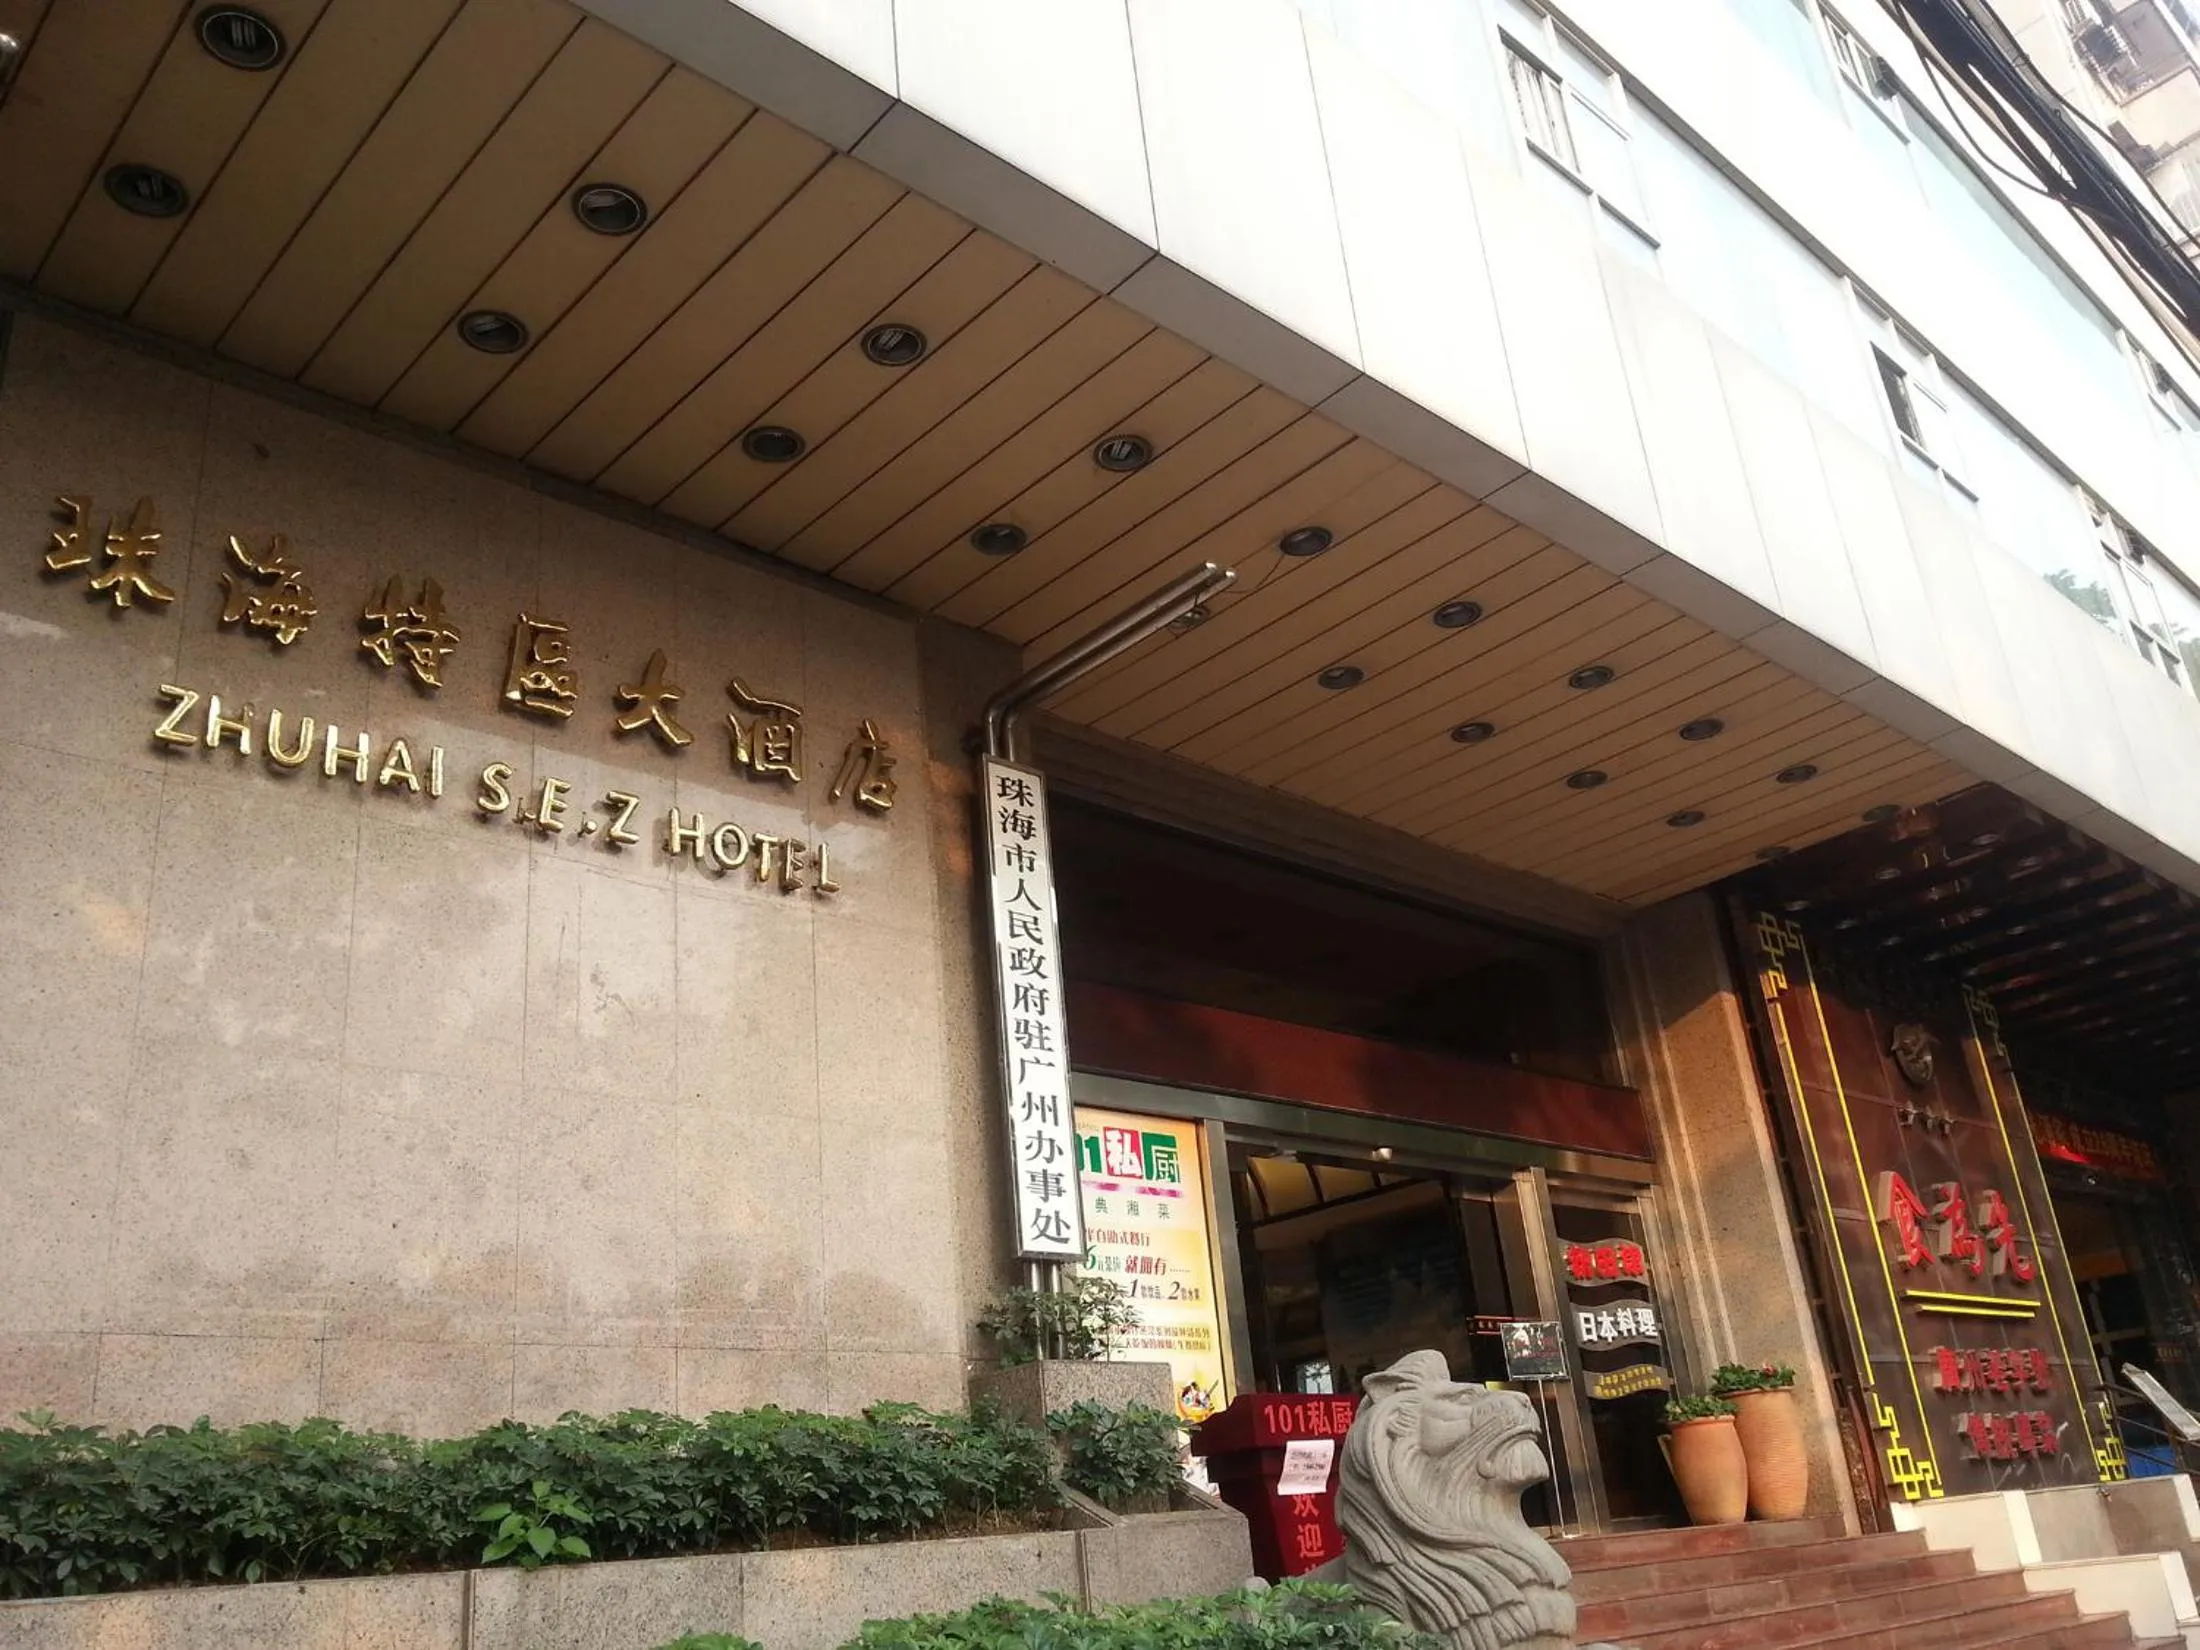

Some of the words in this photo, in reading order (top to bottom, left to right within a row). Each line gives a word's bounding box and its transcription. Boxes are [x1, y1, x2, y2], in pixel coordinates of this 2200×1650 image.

[155, 684, 444, 797] ZHUHAI
[667, 807, 841, 893] HOTEL
[994, 774, 1074, 1244] 珠海市人民政府驻广州办事处
[1579, 1307, 1659, 1342] 日本料理
[1264, 1401, 1353, 1436] 101私厨
[1292, 1494, 1325, 1572] 欢迎
